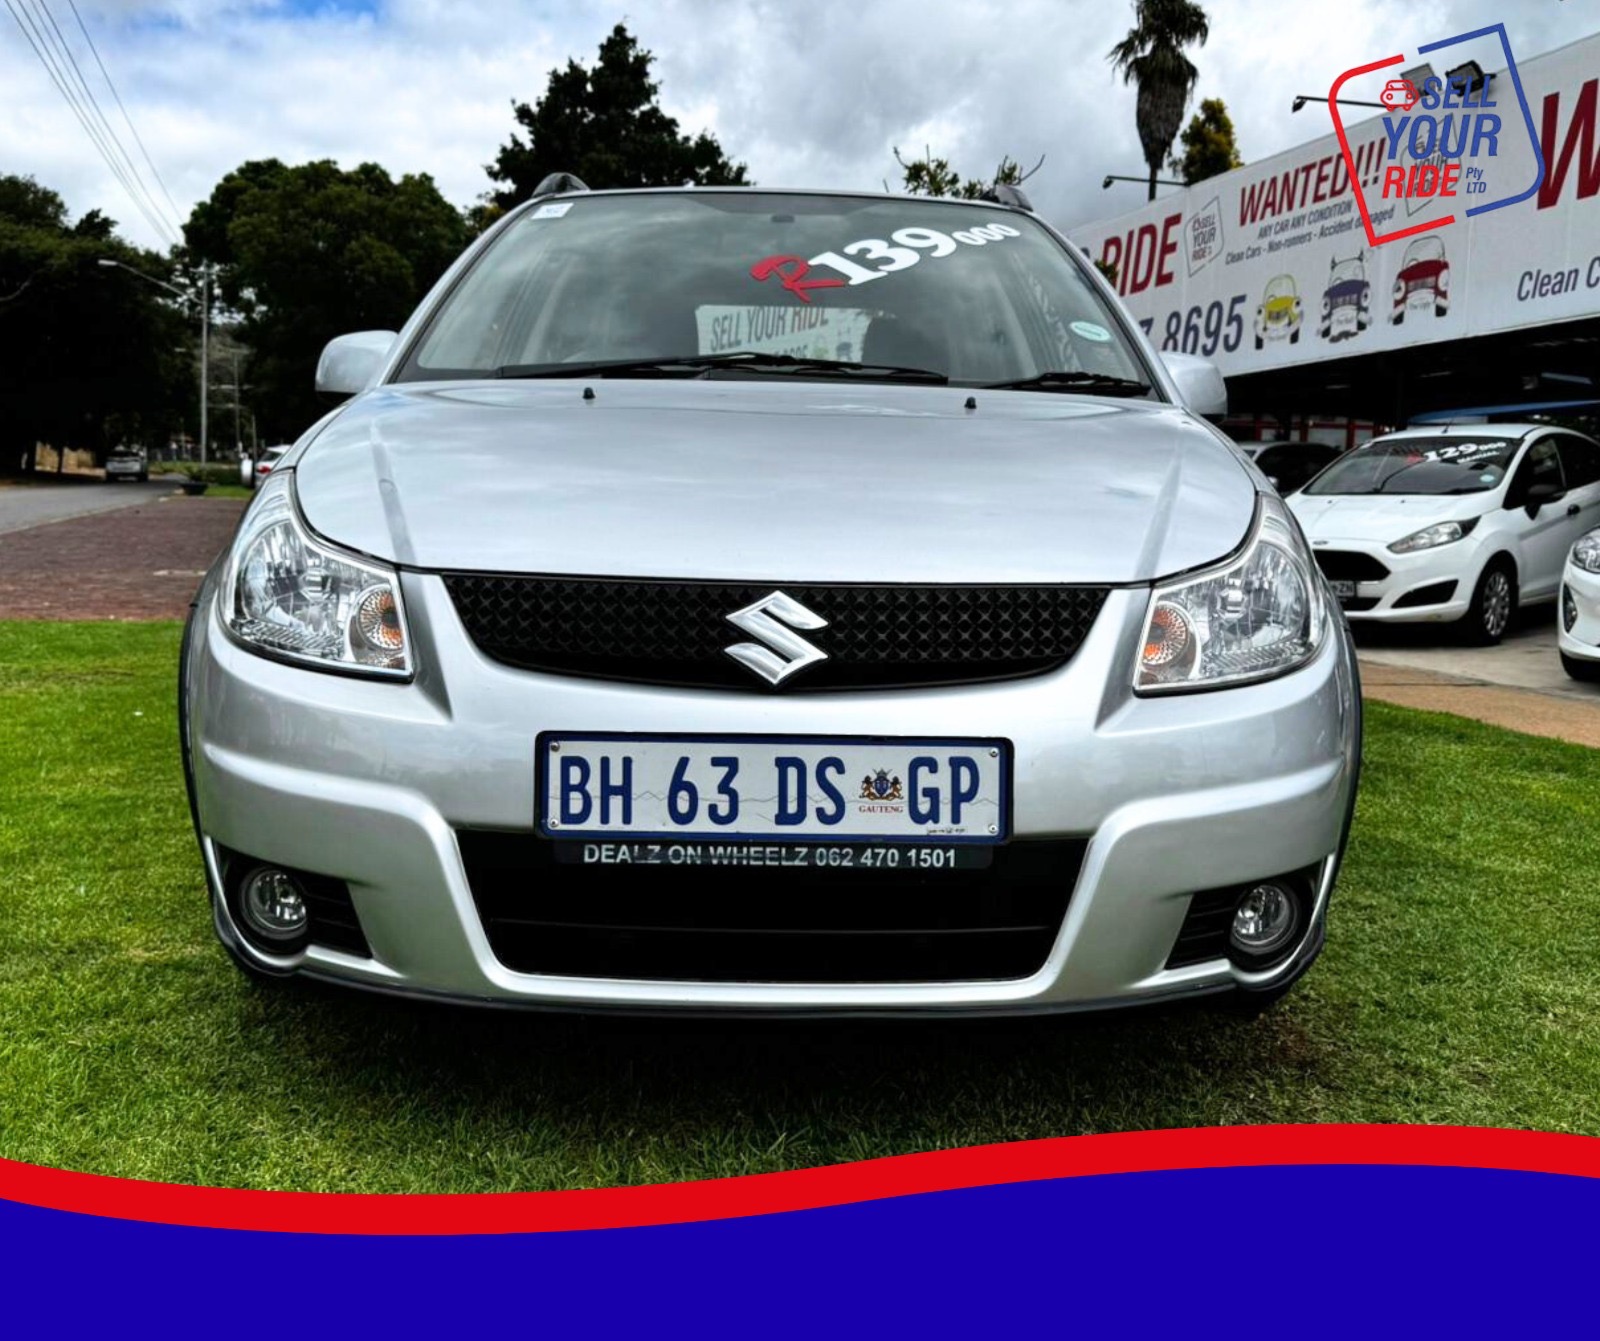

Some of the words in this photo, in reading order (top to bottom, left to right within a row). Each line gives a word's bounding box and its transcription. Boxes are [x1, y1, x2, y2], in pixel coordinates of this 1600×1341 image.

[1193, 227, 1217, 249] YOUR
[1225, 251, 1244, 266] Clean
[1245, 245, 1261, 260] Cars
[1267, 231, 1312, 253] Non-runners
[1318, 217, 1354, 239] Accident
[1355, 203, 1396, 229] daaged
[1258, 223, 1273, 239] ANY
[1274, 218, 1290, 235] CAR
[1290, 213, 1307, 229] ANY
[1307, 199, 1353, 225] CONDITION
[1101, 213, 1182, 297] RIDE
[1516, 268, 1579, 302] Clean
[711, 311, 742, 352] SELL
[747, 307, 786, 343] YOUR
[1161, 294, 1247, 357] 8695
[560, 756, 633, 826] BH
[667, 756, 740, 826] 63
[775, 756, 846, 826] DS
[908, 756, 980, 826] GP
[859, 804, 904, 814] GAUTENG
[583, 844, 662, 864] DEALZ
[668, 845, 702, 865] ON
[708, 845, 808, 867] WHEELZ
[815, 847, 854, 867] 062
[860, 847, 899, 868] 470
[907, 848, 956, 869] 1501
